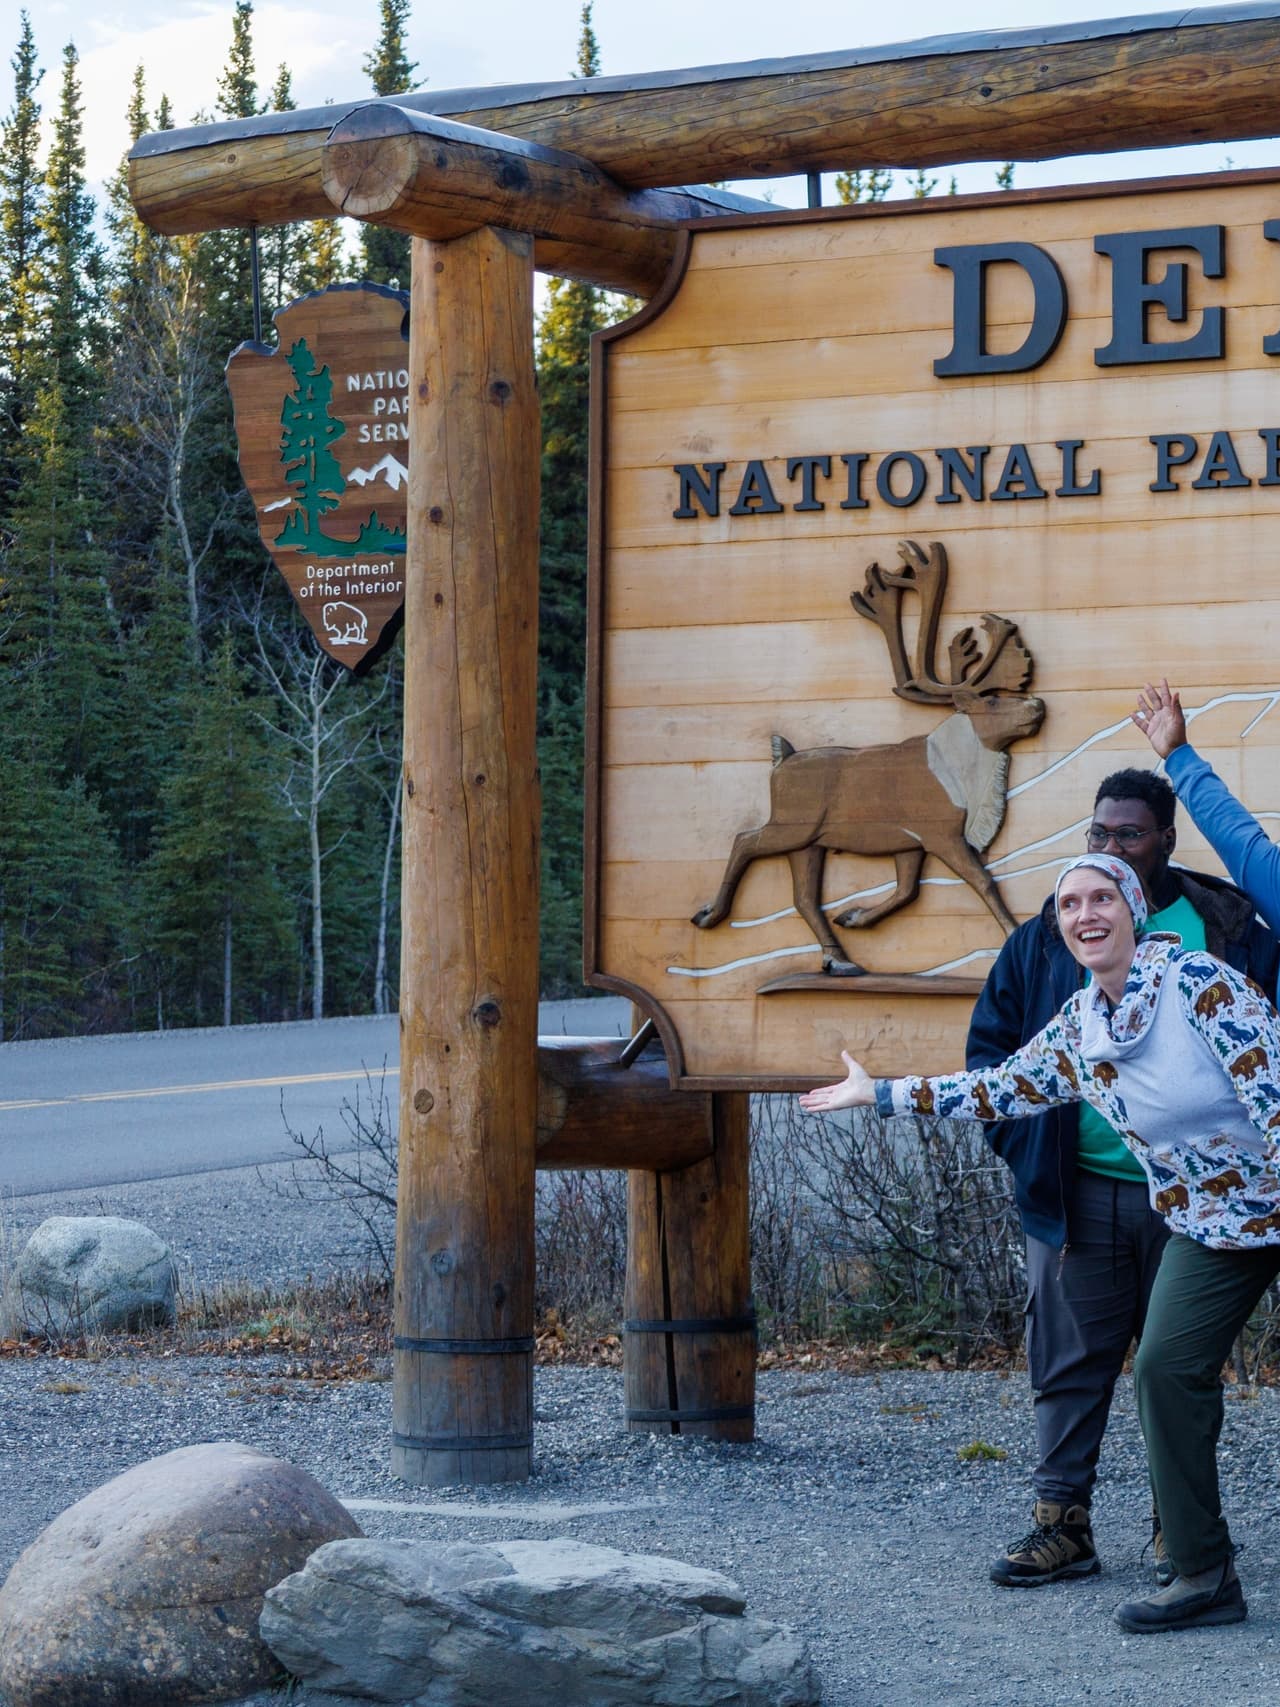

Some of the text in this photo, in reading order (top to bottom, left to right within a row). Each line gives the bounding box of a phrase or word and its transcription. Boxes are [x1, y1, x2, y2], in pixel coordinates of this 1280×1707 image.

[346, 368, 409, 392] NATIO
[358, 421, 409, 443] SERV
[673, 439, 1101, 519] NATIONAL
[306, 560, 394, 581] Department
[300, 578, 403, 598] of the Interior
